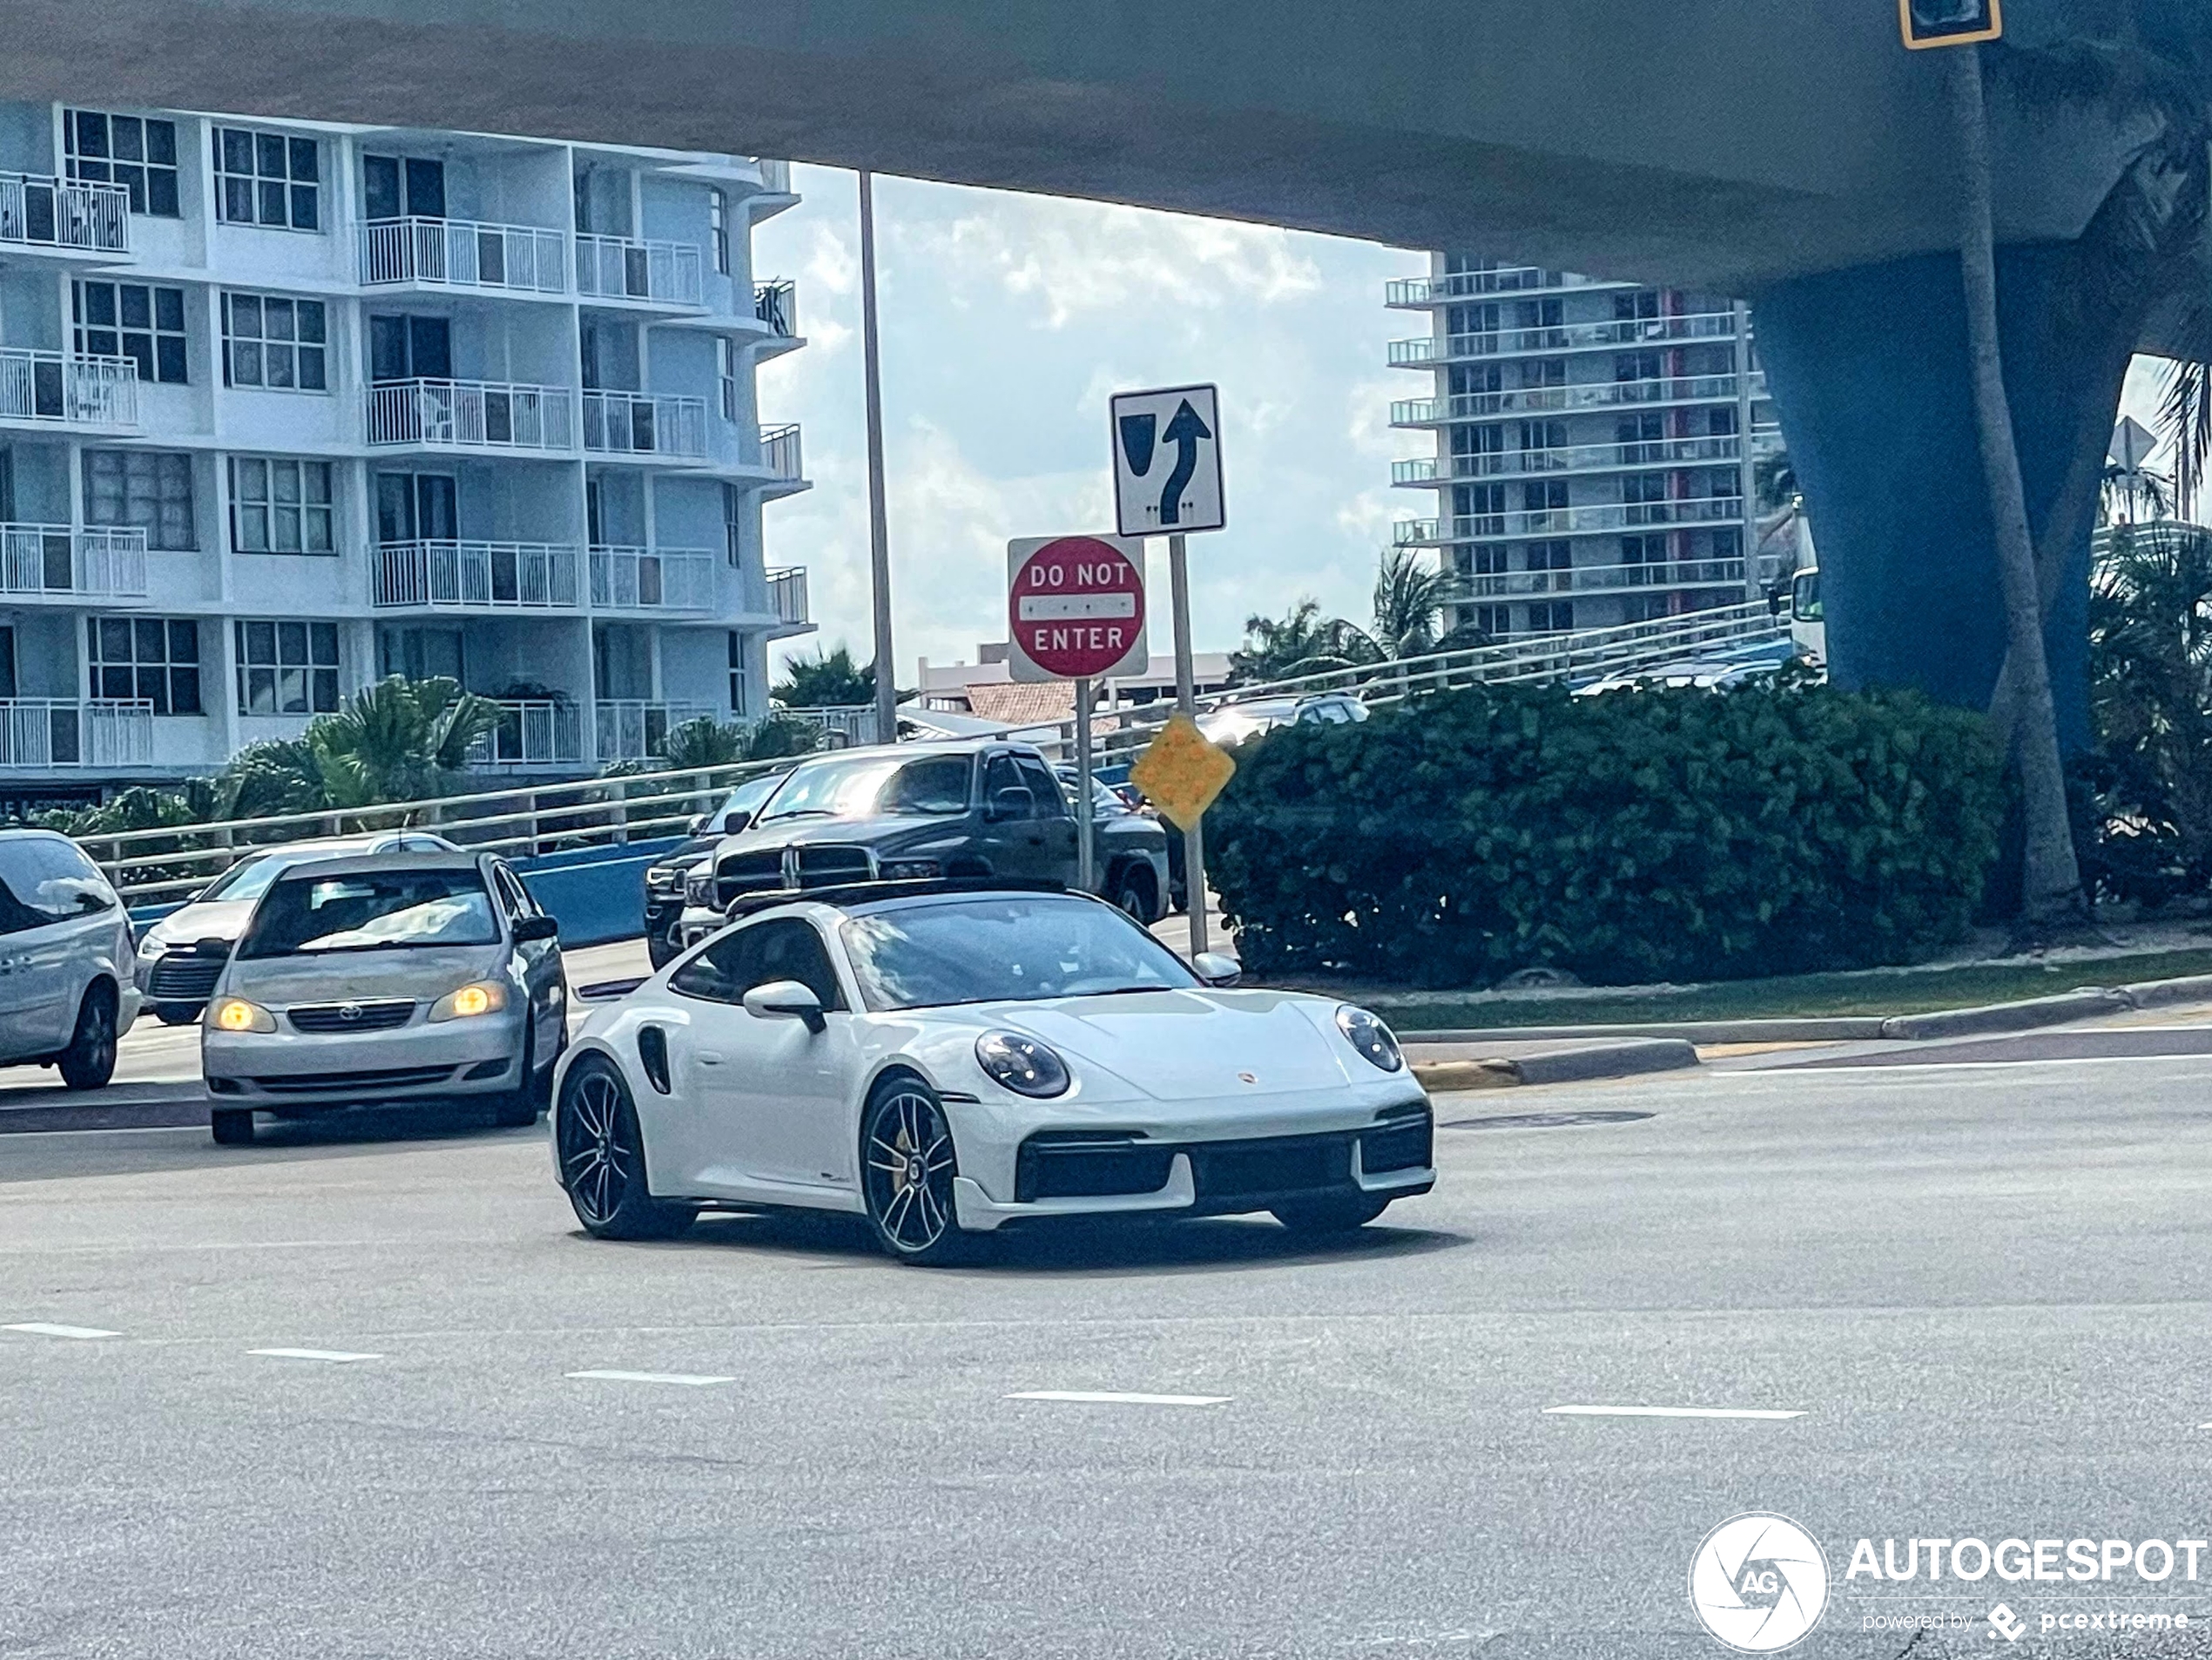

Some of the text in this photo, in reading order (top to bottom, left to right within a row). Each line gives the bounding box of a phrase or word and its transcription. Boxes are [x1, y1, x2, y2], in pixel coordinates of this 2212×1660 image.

[1031, 562, 1128, 587] DO NOT
[1035, 627, 1123, 651] ENTER
